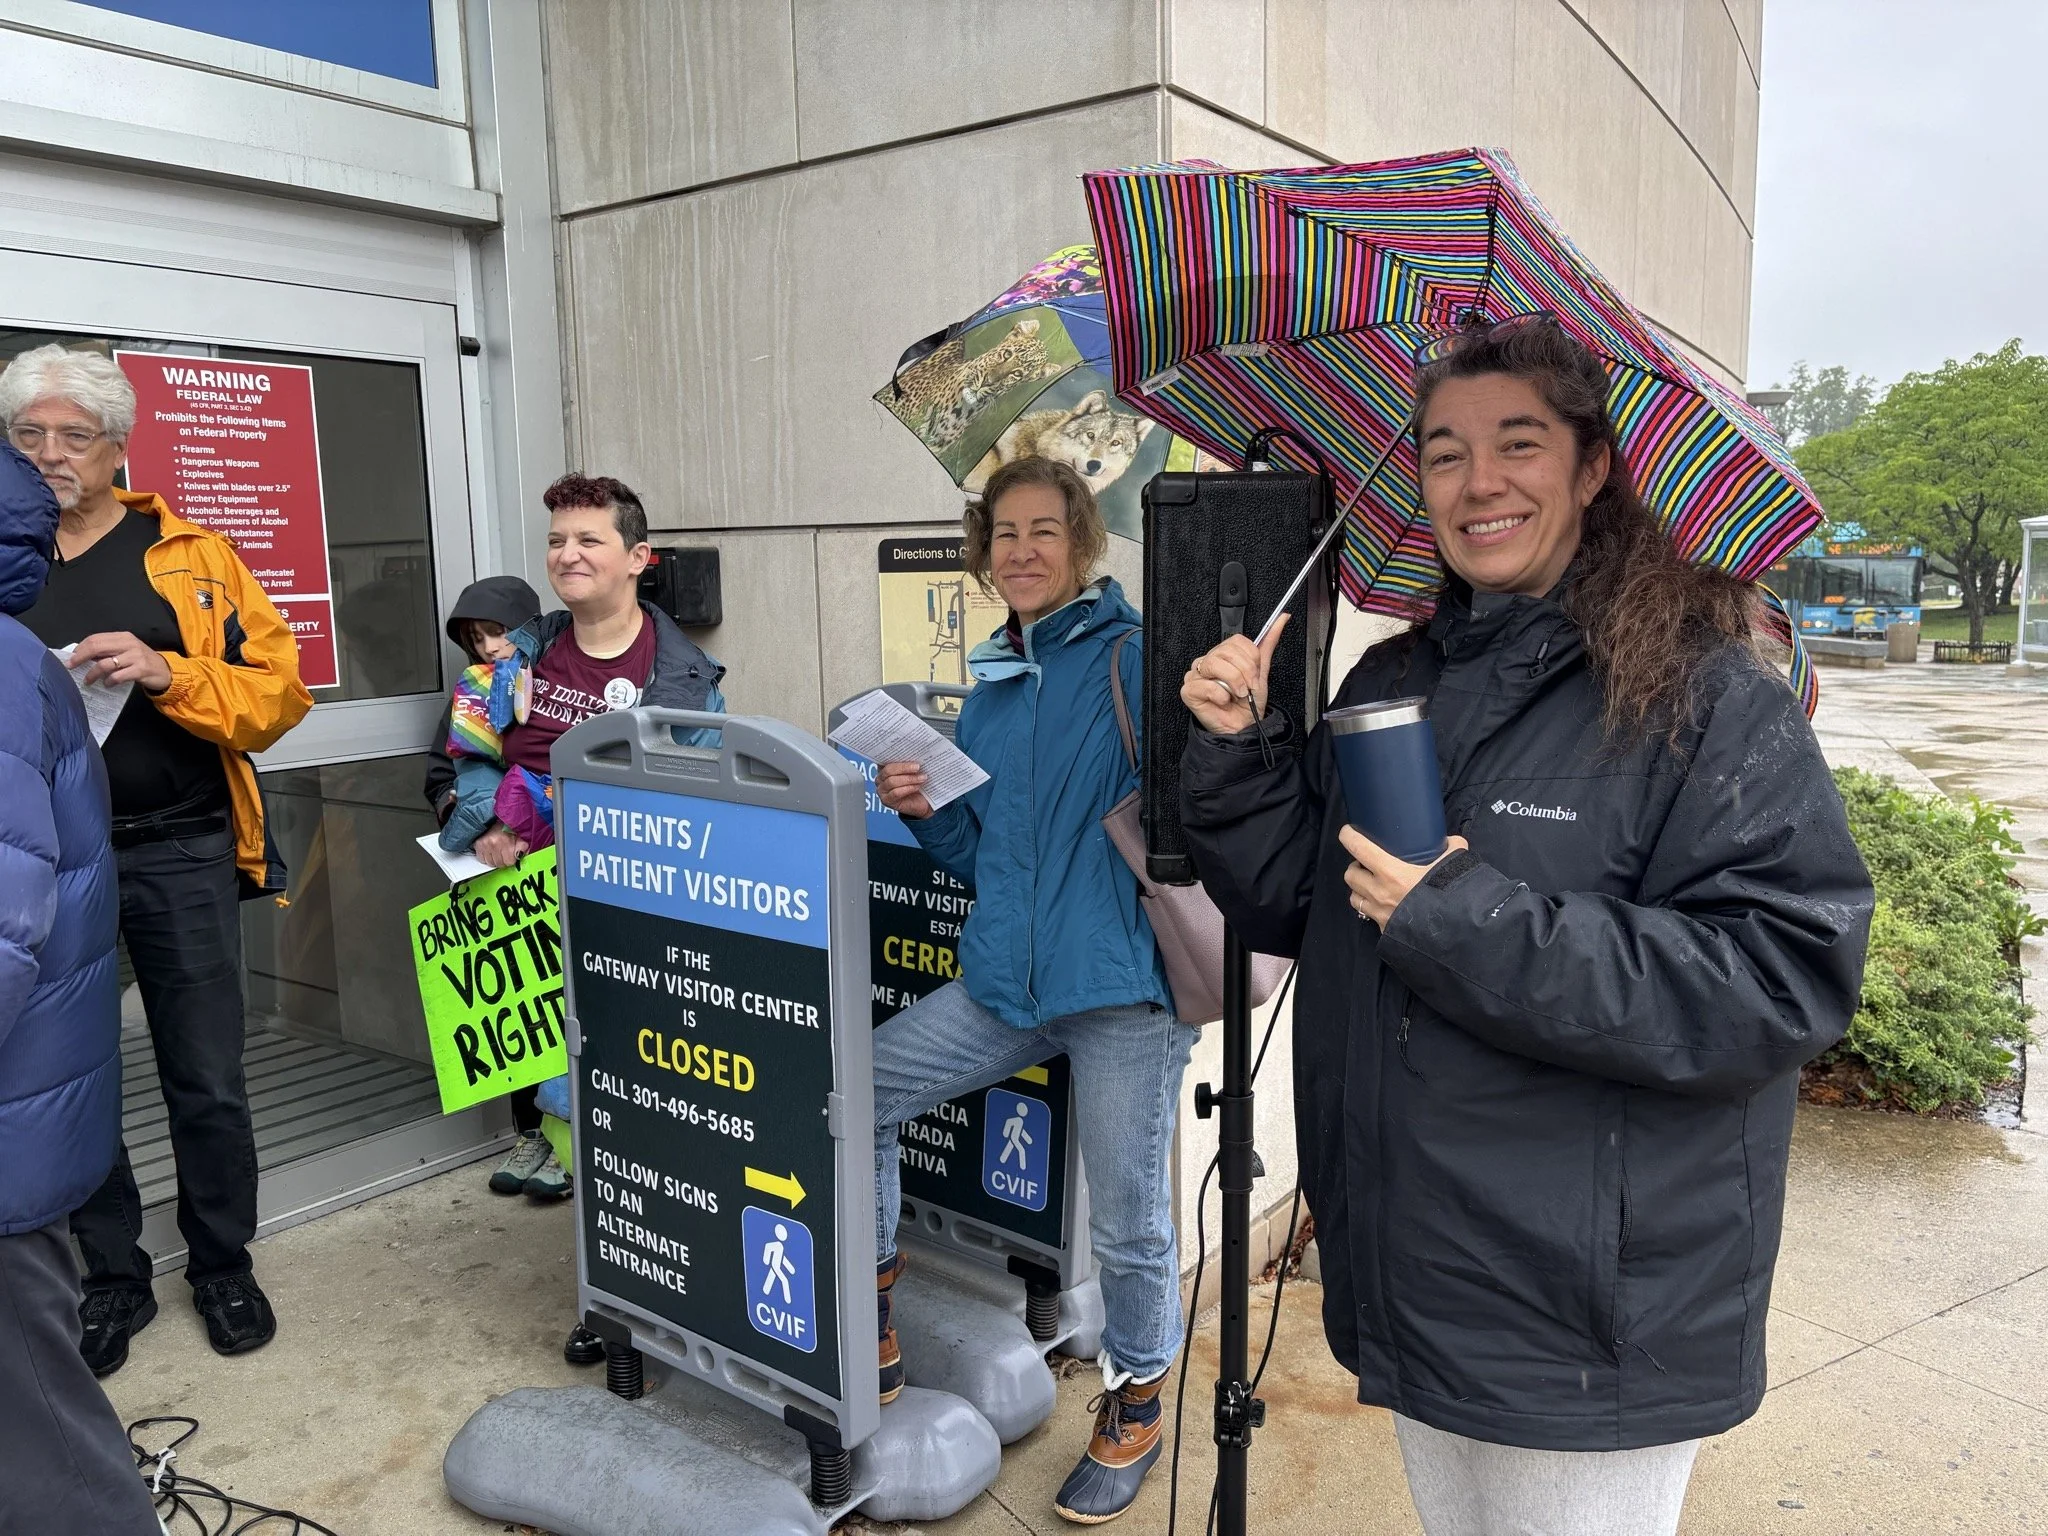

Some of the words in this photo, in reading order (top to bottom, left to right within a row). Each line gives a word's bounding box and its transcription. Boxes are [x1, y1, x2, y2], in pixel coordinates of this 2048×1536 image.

[162, 367, 271, 391] WARNING
[177, 390, 233, 402] FEDERAL
[237, 394, 262, 404] LAW
[155, 411, 197, 423] Prohibits
[200, 413, 214, 424] the
[217, 415, 260, 428] Following
[262, 418, 286, 428] Items
[180, 428, 191, 436] on
[194, 427, 227, 437] Federal
[230, 429, 267, 441] Property
[180, 445, 215, 454] Firearms
[182, 457, 224, 467] Dangerous
[225, 459, 260, 468] Weapons
[183, 470, 224, 479] Explosives
[184, 482, 210, 490] Knives
[212, 483, 229, 491] with
[231, 483, 256, 491] blades
[185, 495, 216, 504] Archery
[218, 495, 258, 504] Equipment
[187, 507, 222, 515] Alcoholic
[224, 507, 264, 516] Beverages
[209, 517, 250, 525] Containers
[230, 529, 273, 537] Substances
[243, 541, 272, 549] Animals
[893, 548, 943, 560] Directions
[946, 548, 956, 558] to
[252, 569, 295, 577] Confiscated
[289, 621, 319, 632] ERTY
[533, 678, 550, 694] TOP
[453, 694, 482, 729] love
[531, 696, 596, 726] LLIONA
[1507, 801, 1577, 821] Columbia
[578, 804, 692, 851] PATIENTS
[699, 822, 712, 859] /
[579, 850, 677, 896] PATIENT
[684, 869, 810, 921] VISITORS
[932, 870, 945, 886] SI
[418, 897, 494, 962] BRING
[496, 870, 558, 927] BACK
[441, 919, 563, 1009] VOTIN
[666, 945, 679, 963] IF
[682, 949, 711, 972] THE
[583, 952, 659, 989] GATEWAY
[664, 973, 736, 1011] VISITOR
[741, 992, 819, 1029] CENTER
[683, 1009, 697, 1028] IS
[453, 986, 566, 1086] RIGHT
[637, 1028, 755, 1092] CLOSED
[591, 1068, 629, 1101] CALL
[633, 1084, 755, 1142] 301-496-5685
[592, 1107, 612, 1132] OR
[900, 1121, 956, 1152] TRADA
[899, 1145, 947, 1177] ATIVA
[594, 1146, 659, 1191] FOLLOW
[664, 1176, 719, 1214] SIGNS
[991, 1170, 1038, 1200] CVIF
[594, 1178, 615, 1203] TO
[620, 1189, 643, 1216] AN
[597, 1210, 691, 1267] ALTERNATE
[599, 1240, 687, 1295] ENTRANCE
[756, 1302, 806, 1339] CVIF
